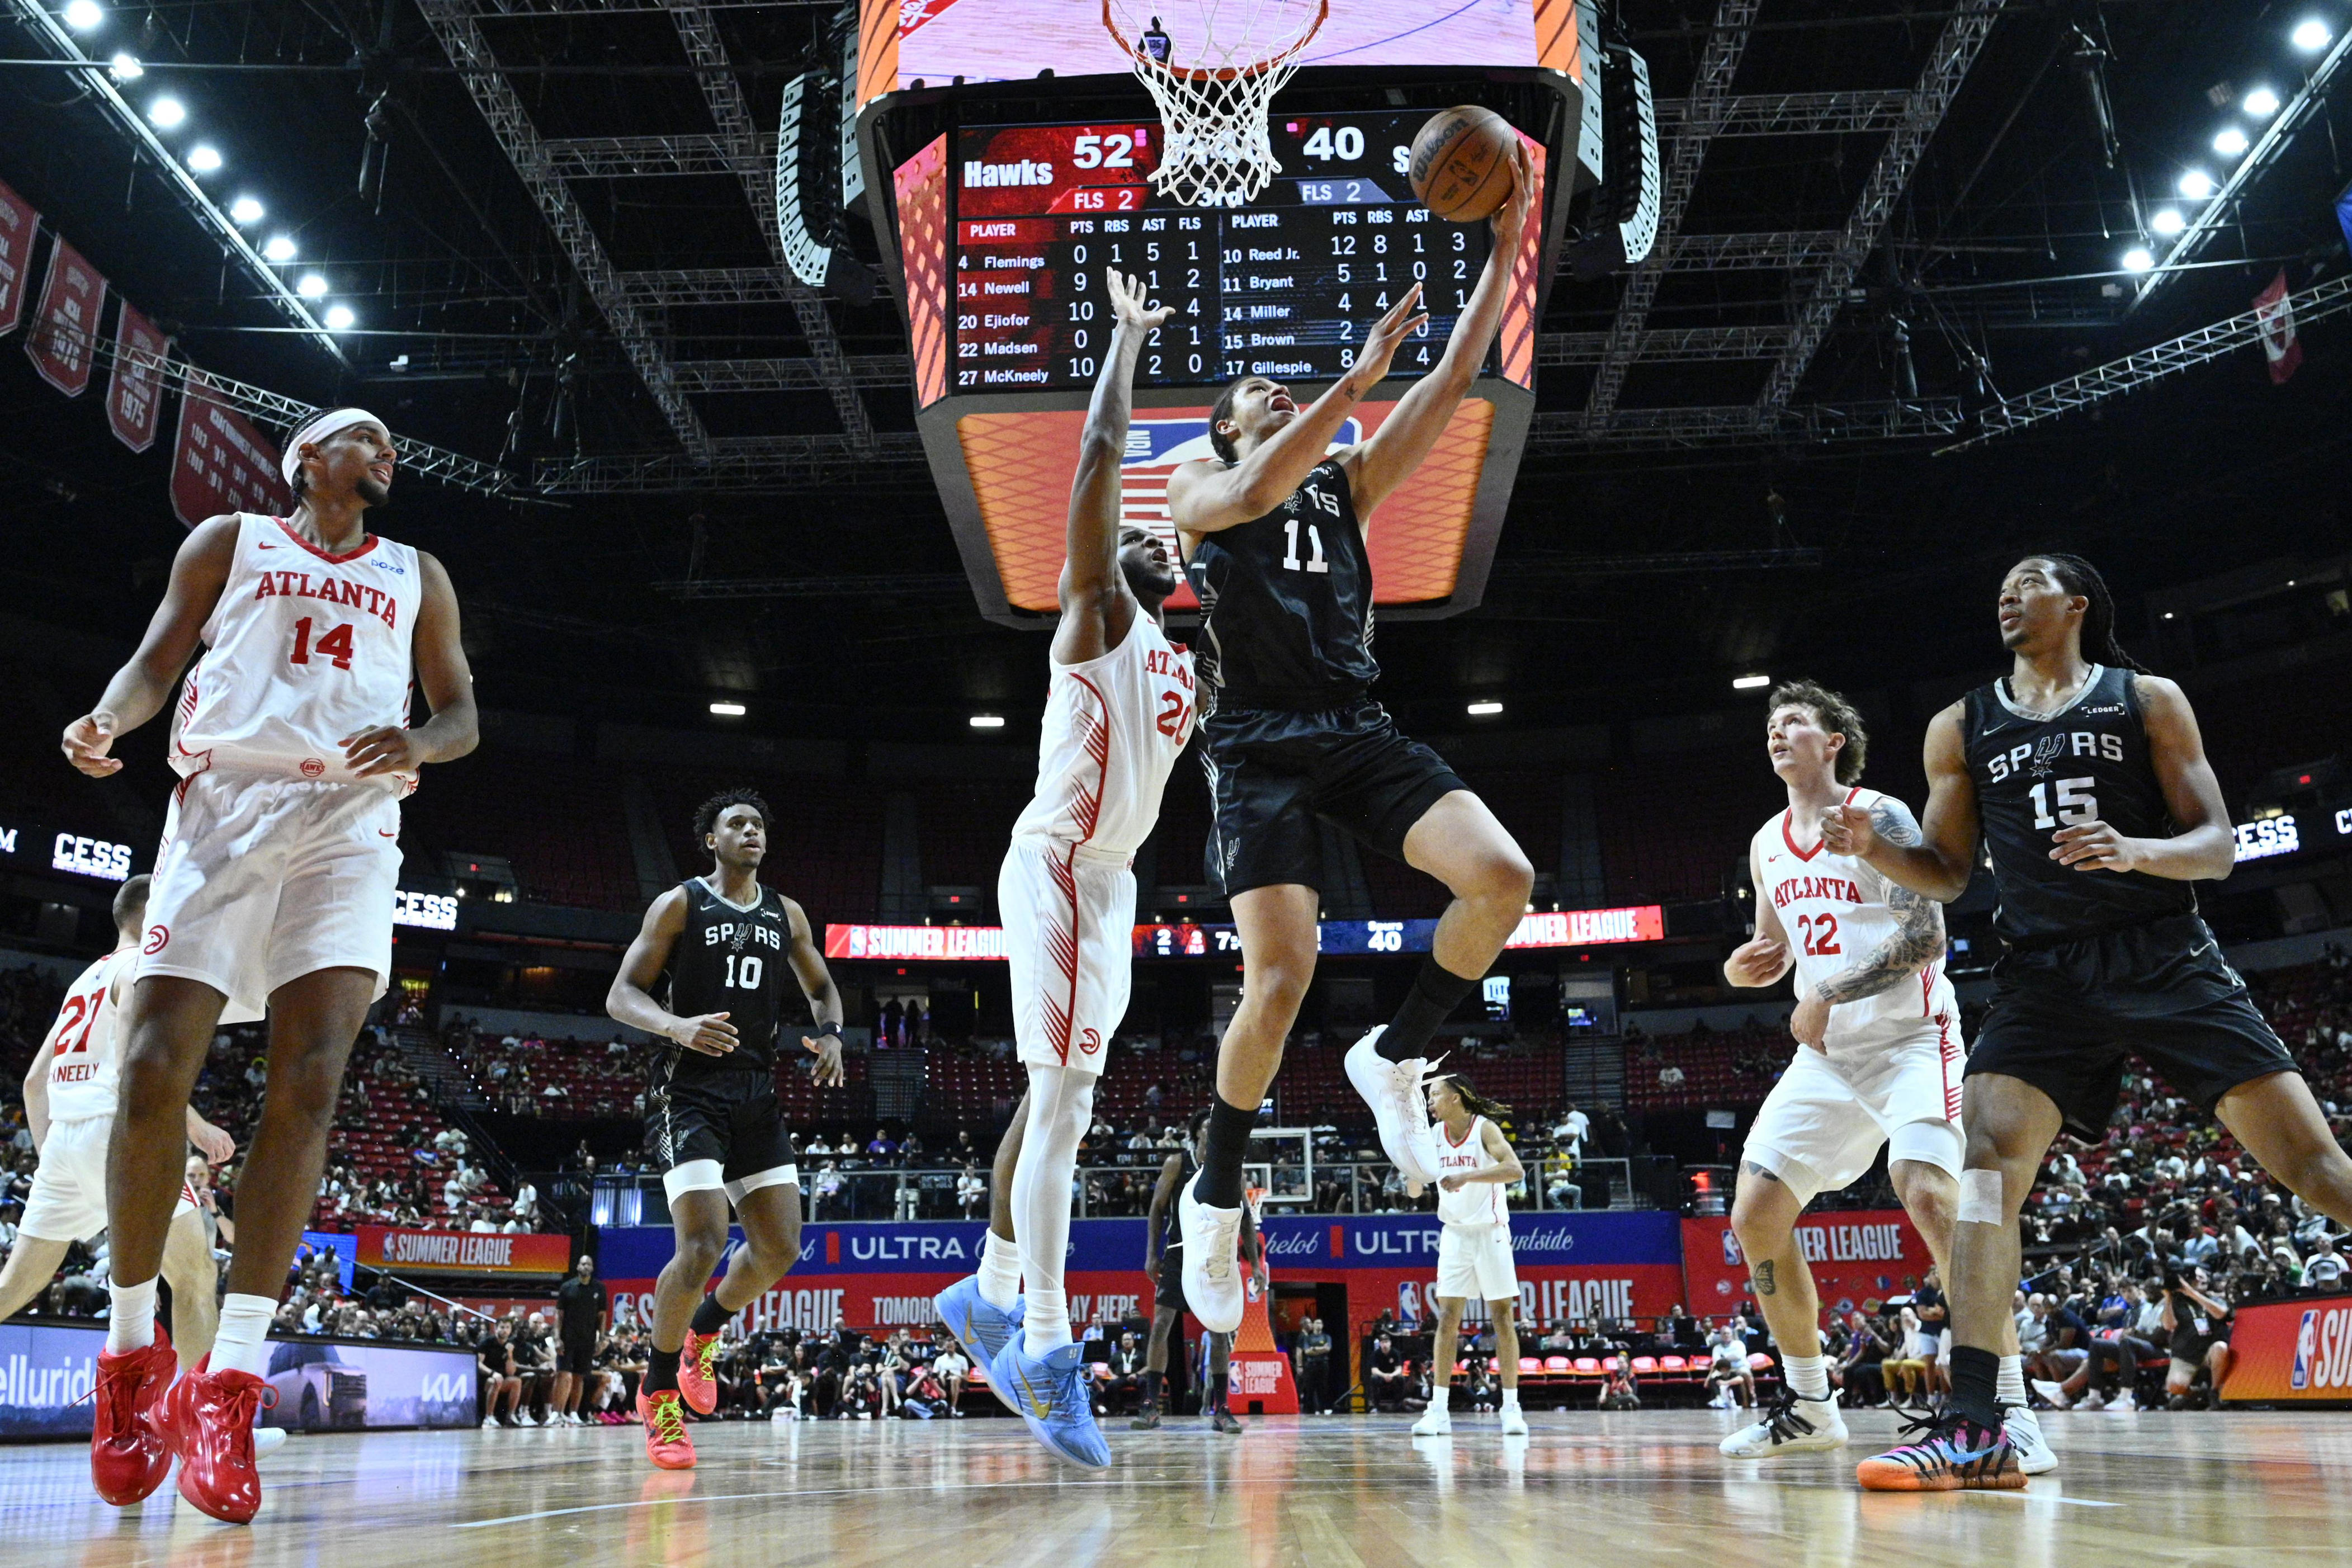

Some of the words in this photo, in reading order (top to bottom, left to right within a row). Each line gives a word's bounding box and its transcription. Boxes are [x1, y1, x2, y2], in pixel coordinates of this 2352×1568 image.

[1073, 134, 1133, 169] 52
[1303, 127, 1364, 161] 40
[1412, 118, 1470, 183] Wilson
[964, 160, 1053, 188] Hawks
[1074, 192, 1104, 210] FLS
[1118, 191, 1133, 210] 2
[1197, 186, 1244, 207] 3rd
[1302, 184, 1332, 201] FLS
[1347, 182, 1361, 202] 2
[970, 223, 1016, 238] PLAYER
[1070, 220, 1094, 234] PTS
[1104, 219, 1130, 232] RBS
[1142, 218, 1166, 232] AST
[1179, 217, 1201, 230] FLS
[1232, 214, 1278, 228] PLAYER
[1333, 211, 1357, 225] PTS
[1367, 210, 1393, 223] RBS
[1406, 209, 1429, 223] AST
[959, 256, 968, 270] 4
[984, 254, 1045, 270] Flemings
[1074, 245, 1087, 264] 0
[1111, 243, 1122, 262] 1
[1147, 242, 1159, 261] 5
[1188, 241, 1199, 259] 1
[1223, 250, 1241, 263] 10
[1249, 248, 1282, 261] Reed
[1285, 248, 1300, 261] Jr.
[1331, 235, 1356, 256] 12
[1374, 235, 1387, 254] 8
[1414, 234, 1424, 253] 1
[1452, 232, 1466, 251] 3
[959, 284, 977, 297] 14
[984, 281, 1030, 295] Newell
[1074, 273, 1087, 292] 9
[1149, 270, 1160, 289] 1
[1187, 269, 1200, 288] 2
[1223, 278, 1241, 292] 11
[1249, 276, 1294, 290] Bryant
[1338, 263, 1351, 282] 5
[1376, 262, 1388, 281] 1
[1413, 261, 1427, 280] 0
[1453, 259, 1467, 279] 2
[958, 316, 977, 330] 20
[984, 314, 1030, 329] Ejiofor
[1069, 301, 1094, 321] 10
[1187, 297, 1201, 317] 4
[1224, 308, 1243, 322] 14
[1250, 305, 1291, 319] Miller
[1338, 292, 1352, 312] 4
[1376, 291, 1390, 311] 4
[1416, 290, 1428, 310] 1
[1456, 289, 1468, 309] 1
[958, 343, 978, 357] 22
[984, 341, 1038, 356] Madsen
[1074, 330, 1088, 349] 0
[1149, 327, 1161, 347] 2
[1189, 326, 1201, 345] 1
[1224, 336, 1243, 350] 15
[1251, 333, 1295, 347] Brown
[1340, 321, 1353, 341] 2
[1416, 320, 1429, 338] 0
[958, 371, 978, 385] 27
[984, 369, 1049, 384] McKneely
[1069, 357, 1094, 377] 10
[1149, 355, 1161, 375] 2
[1188, 354, 1202, 373] 0
[1225, 361, 1244, 375] 17
[1251, 360, 1312, 375] Gillespie
[1340, 349, 1354, 369] 8
[1416, 346, 1430, 366] 4
[1123, 429, 1153, 458] NBA
[1283, 519, 1328, 573] 11
[255, 570, 396, 630] ATLANTA
[290, 616, 353, 670] 14
[2087, 706, 2119, 714] LEDGER
[1987, 731, 2123, 783] SPURS
[2029, 776, 2099, 830] 15
[54, 833, 133, 872] CESS
[1774, 876, 1864, 909] ATLANTA
[705, 923, 780, 952] SPURS
[868, 928, 944, 956] SUMMER
[1157, 928, 1172, 946] 2
[1191, 931, 1202, 944] 2
[1368, 931, 1402, 952] 40
[1506, 914, 1568, 946] MMER
[1571, 910, 1638, 942] LEAGUE
[1797, 912, 1841, 957] 22
[725, 955, 763, 990] 10
[54, 986, 107, 1057] 27
[1440, 1155, 1478, 1168] TLANTA
[396, 1234, 459, 1263] SUMMER
[460, 1237, 514, 1266] LEAGUE
[852, 1236, 966, 1260] ULTRA
[1356, 1231, 1441, 1255] ULTR
[1510, 1226, 1574, 1251] urtside
[1829, 1224, 1904, 1262] LEAGUE
[1245, 1361, 1283, 1378] SUMMER
[422, 1373, 467, 1404] KIA
[1245, 1377, 1277, 1394] LEAGUE
